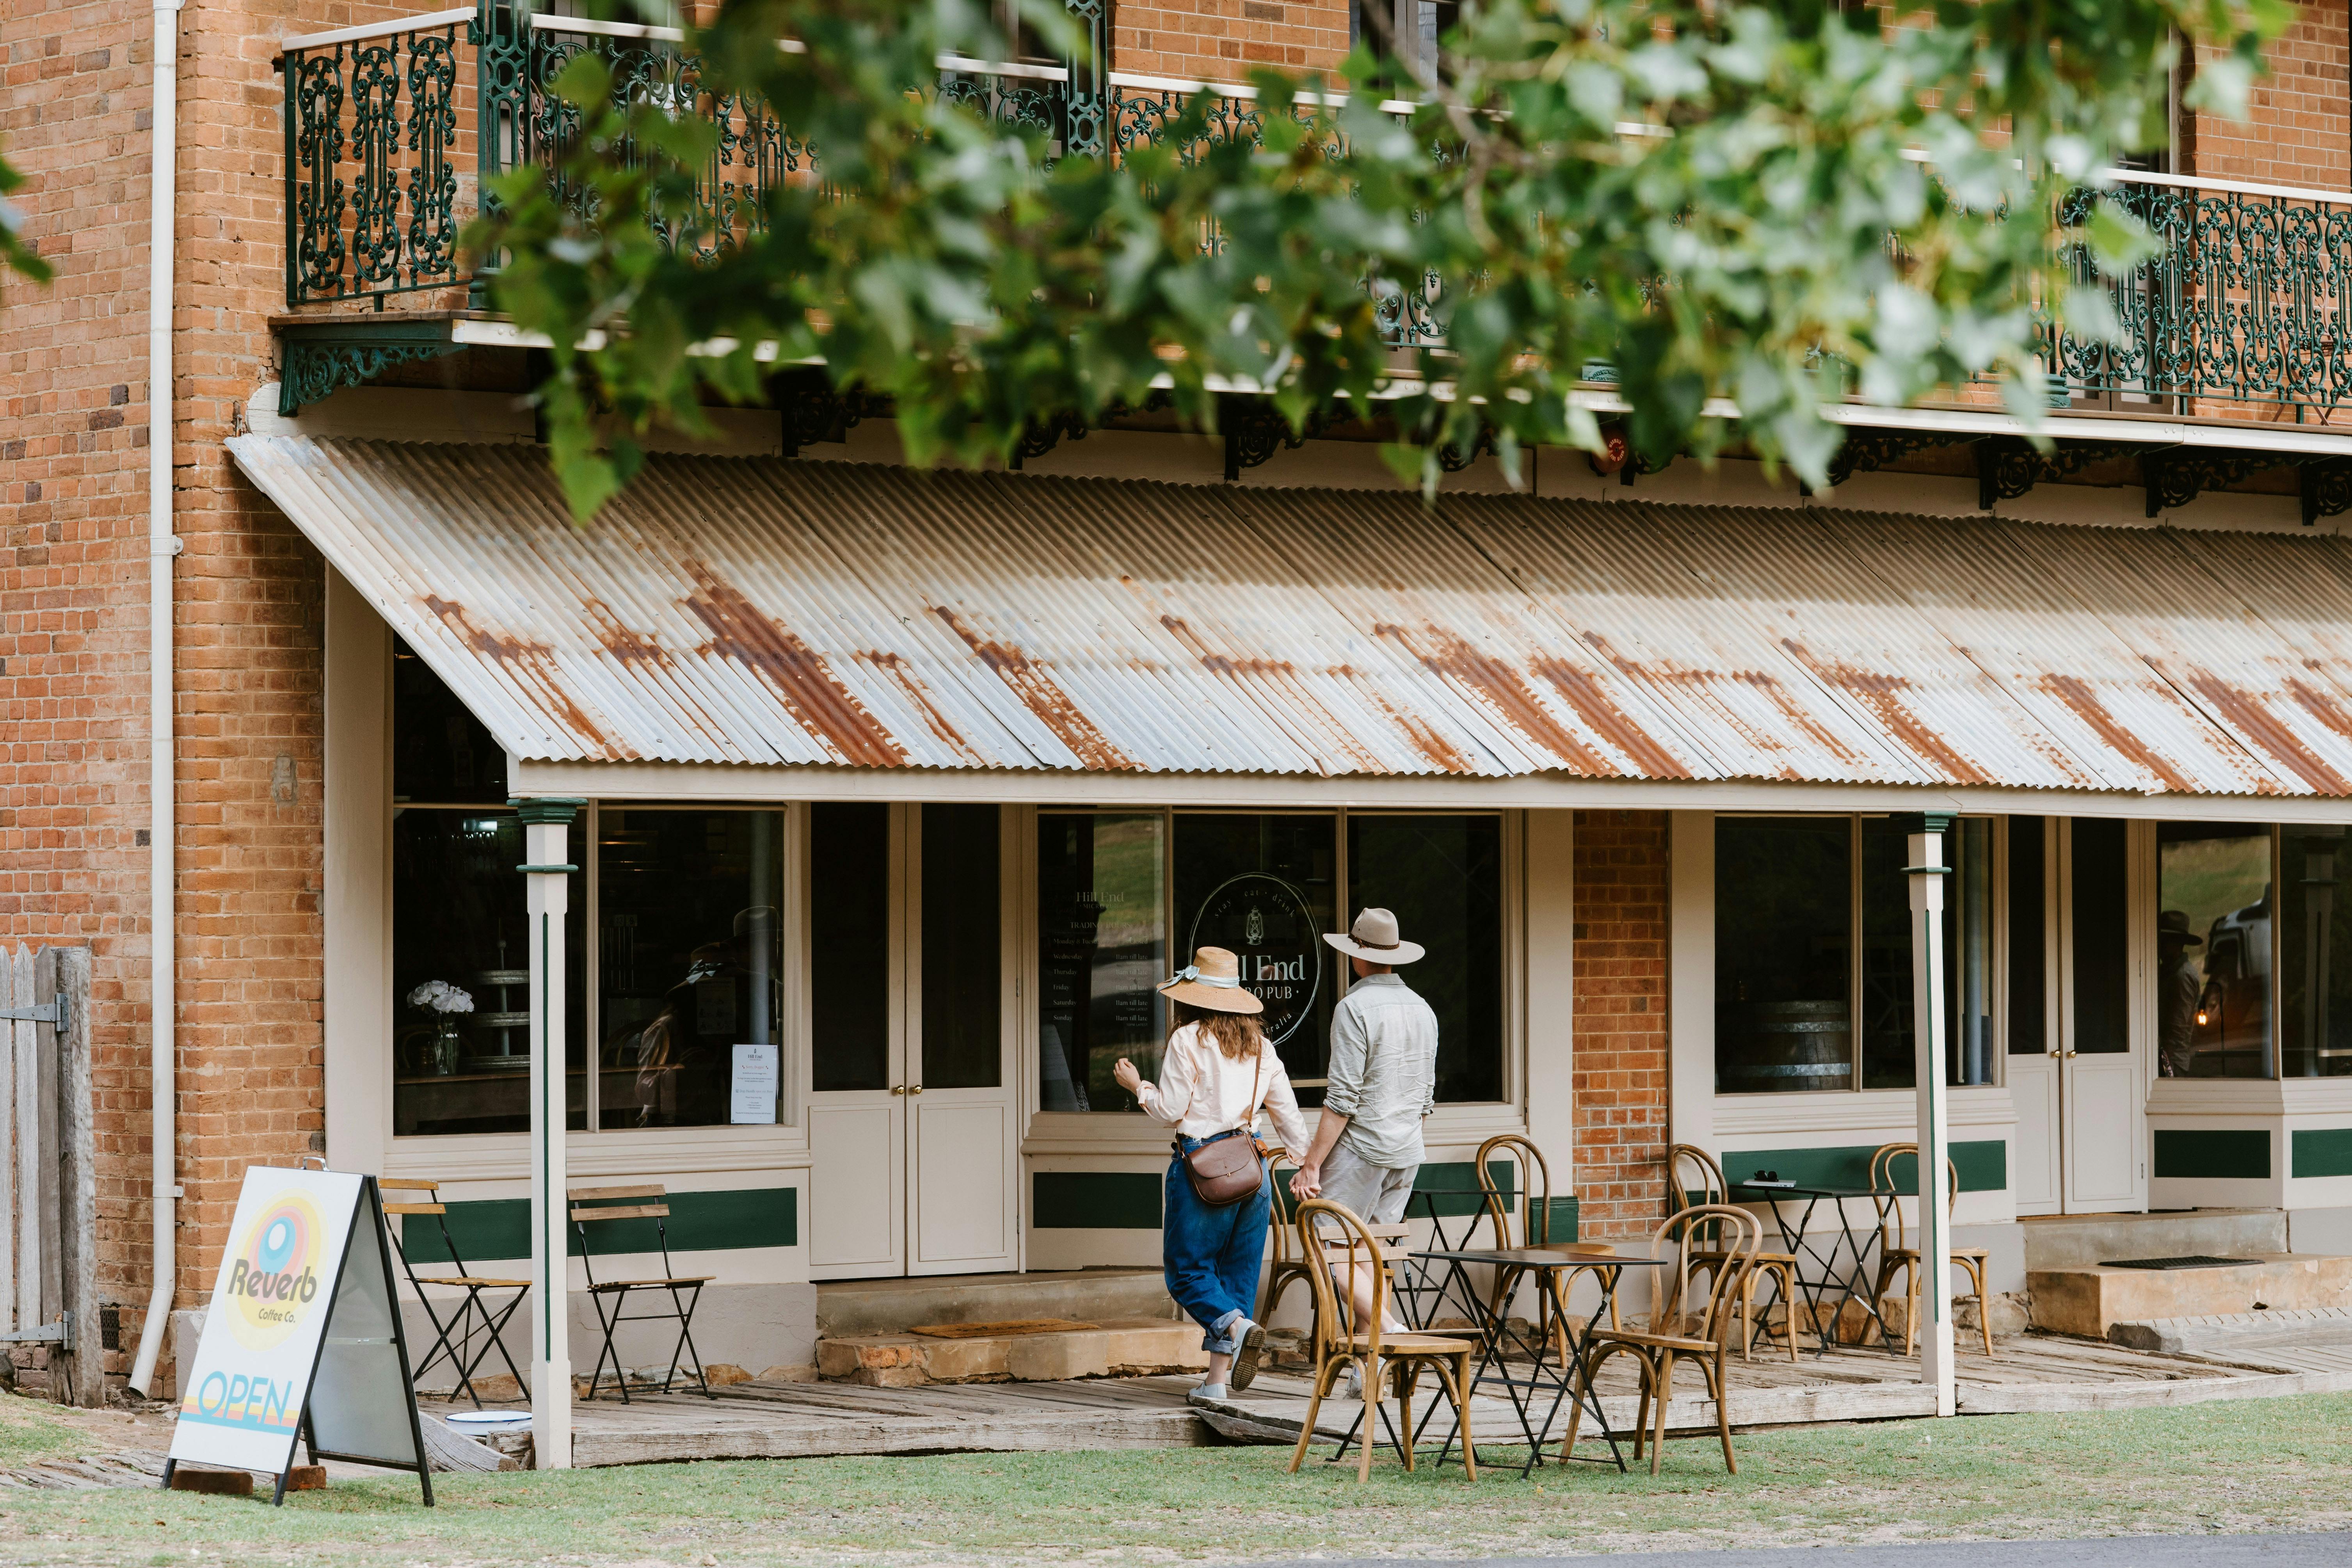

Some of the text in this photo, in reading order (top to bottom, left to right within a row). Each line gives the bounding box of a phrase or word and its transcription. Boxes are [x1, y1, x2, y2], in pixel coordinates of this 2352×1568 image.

[1077, 892, 1124, 902] Hill End
[1215, 899, 1230, 918] stay
[1272, 894, 1294, 918] drink
[1256, 954, 1306, 980] End
[1267, 987, 1292, 999] PUB
[228, 1259, 316, 1303] Reverb
[259, 1308, 295, 1323] Coffee Co.
[198, 1371, 292, 1426] OPEN
